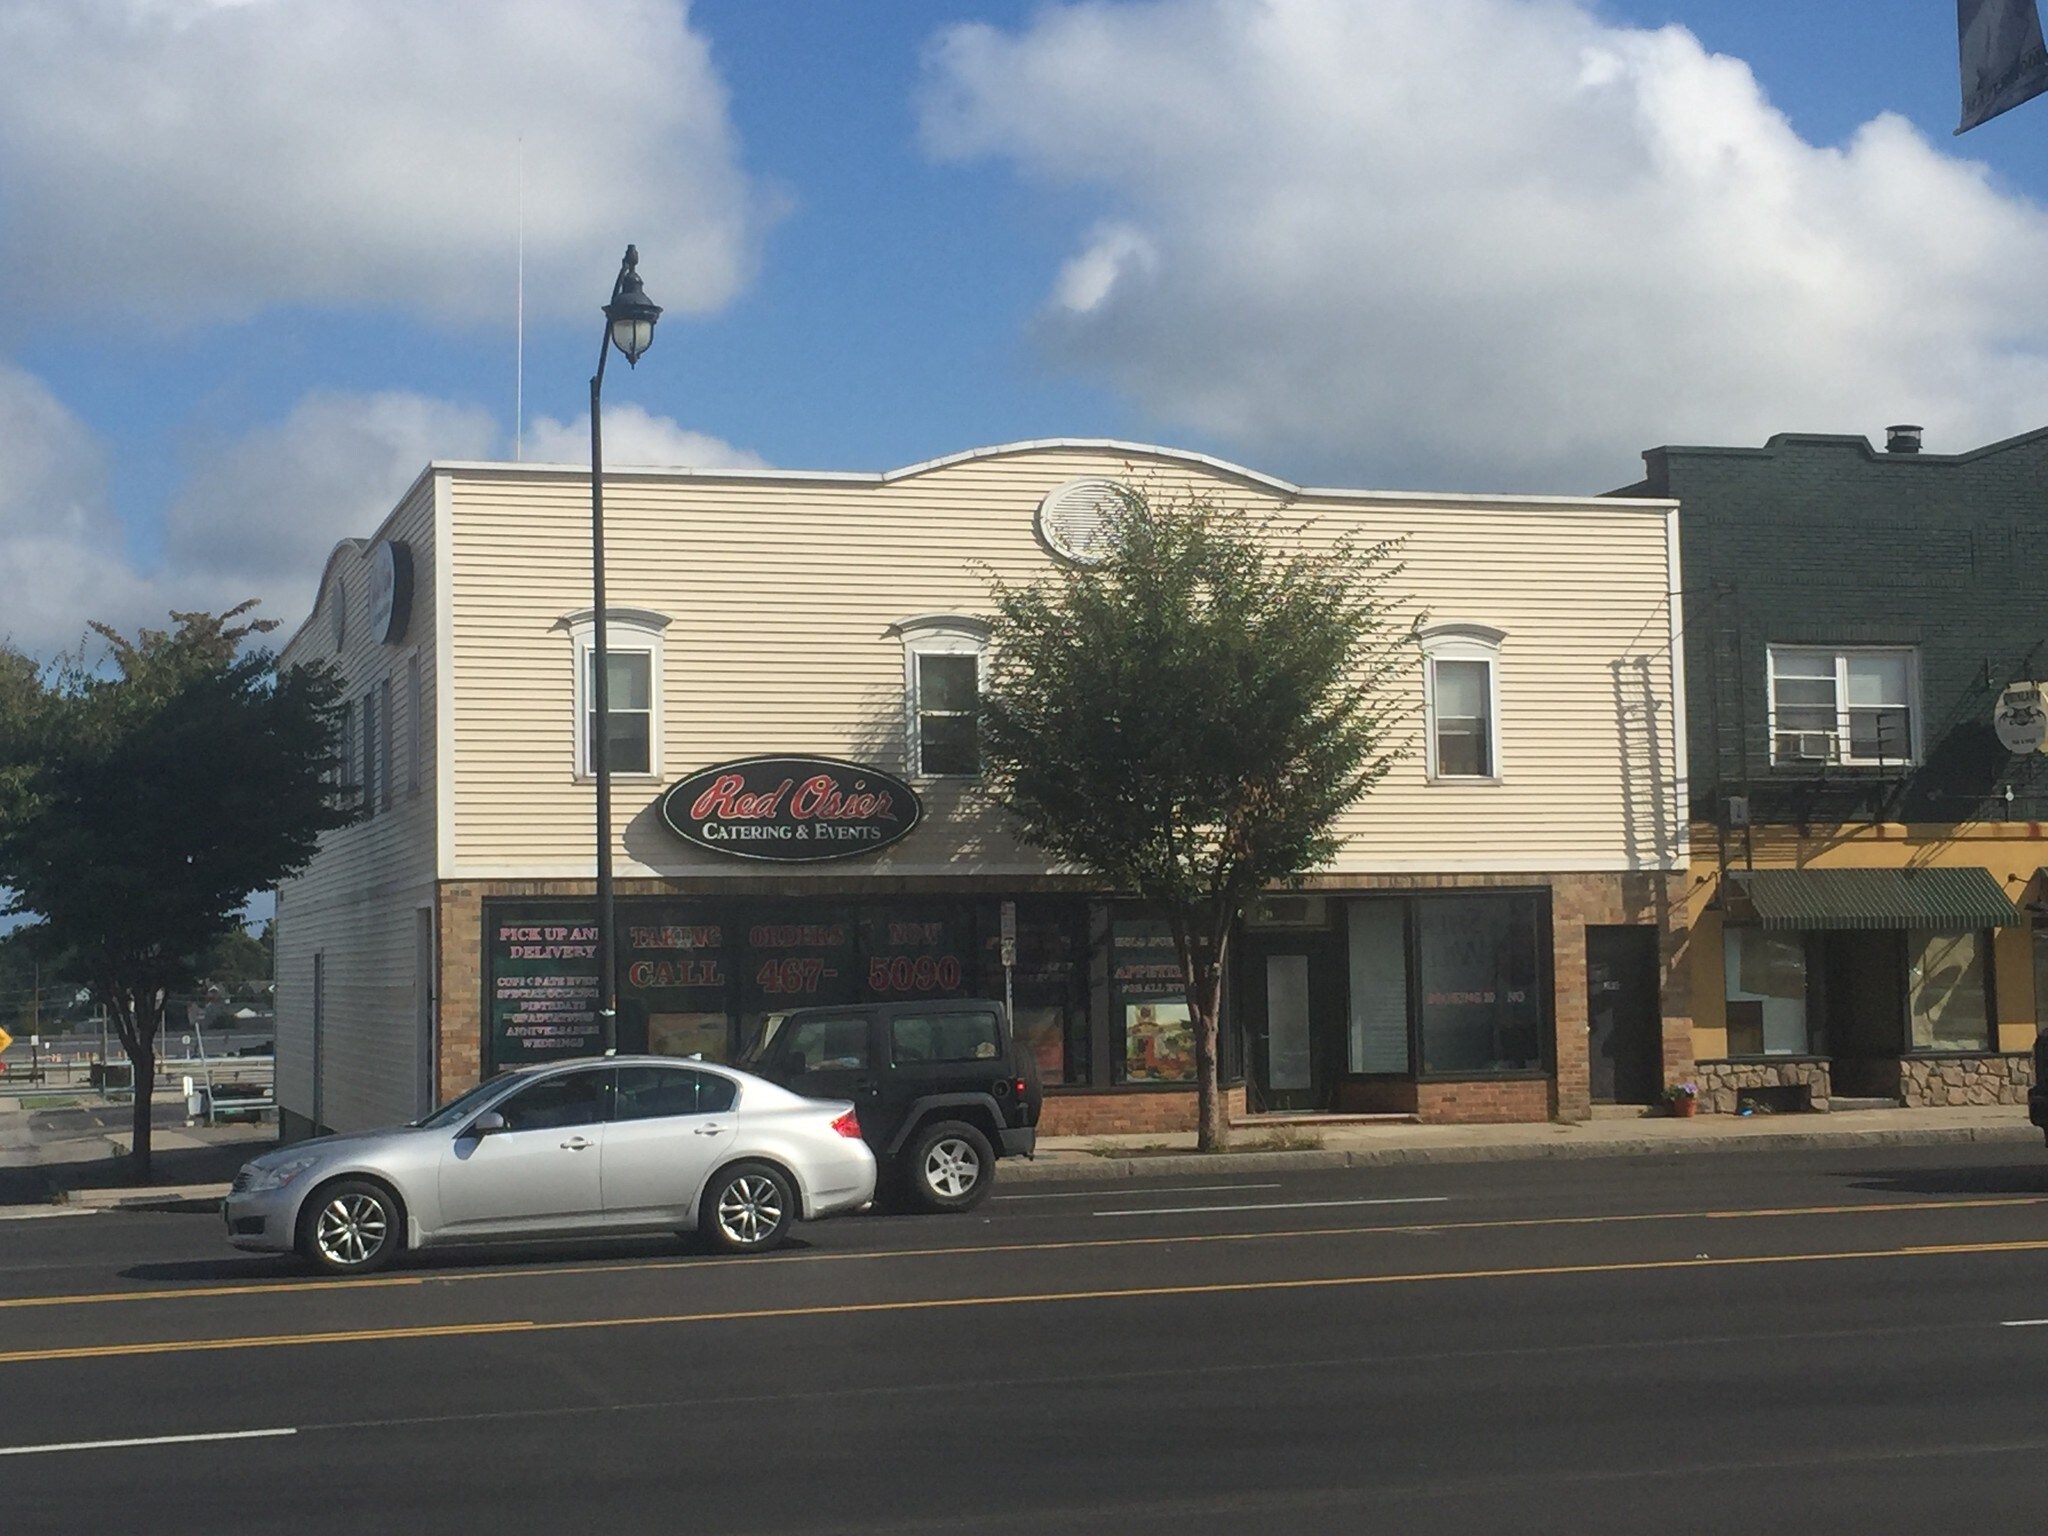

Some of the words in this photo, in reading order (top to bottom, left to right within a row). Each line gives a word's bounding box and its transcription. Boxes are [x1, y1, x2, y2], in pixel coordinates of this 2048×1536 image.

[690, 774, 794, 820] Red
[790, 774, 899, 822] Osier
[702, 822, 792, 840] CATERING
[795, 822, 809, 840] &
[814, 822, 882, 840] EVENTS
[500, 927, 542, 941] PICK
[544, 927, 568, 941] UP
[630, 925, 722, 949] TAKING
[749, 924, 845, 947] ORDERS
[511, 946, 596, 959] DELIVERY
[629, 960, 725, 989] CALL
[757, 957, 839, 993] 467-
[867, 955, 962, 993] 5090
